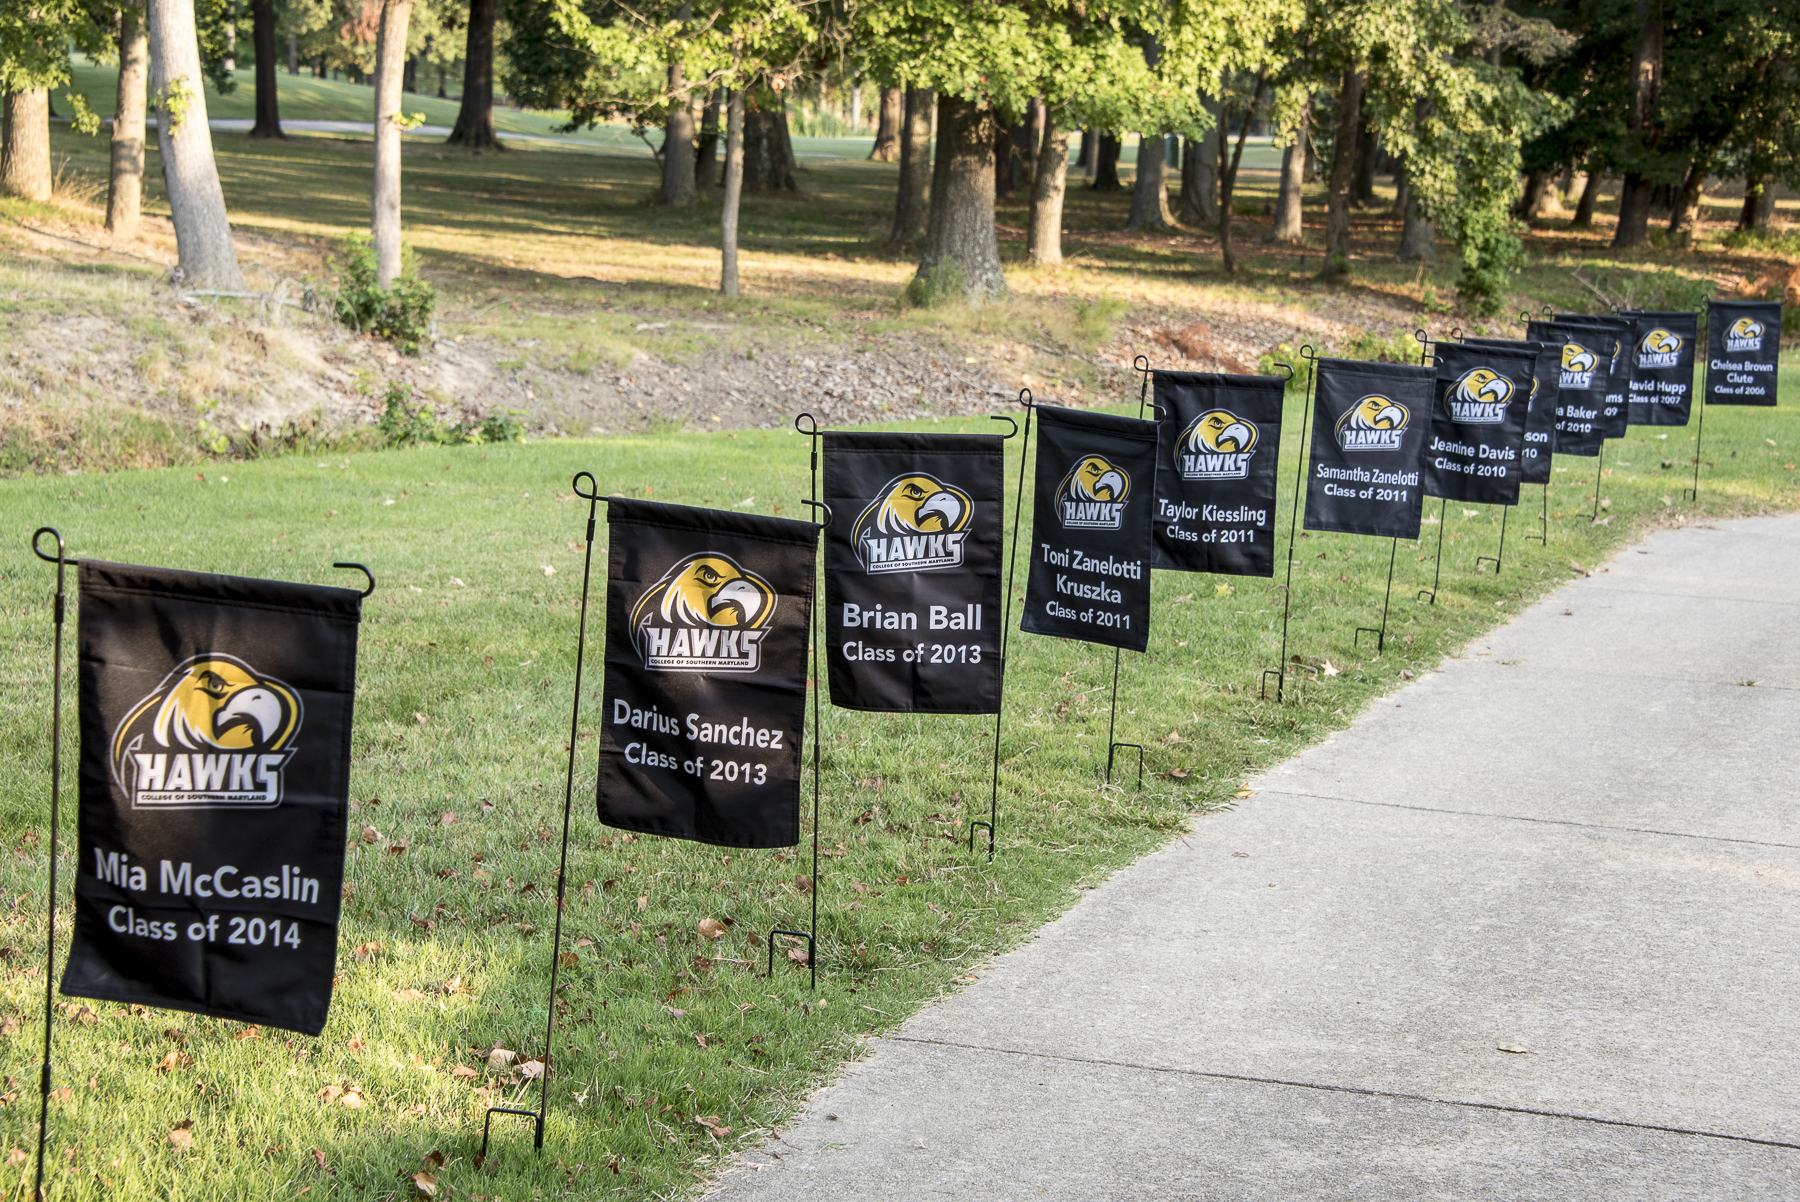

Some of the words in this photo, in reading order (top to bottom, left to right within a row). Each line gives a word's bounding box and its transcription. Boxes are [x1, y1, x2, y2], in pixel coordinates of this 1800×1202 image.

[1727, 337, 1762, 349] HAWKS
[1639, 352, 1679, 366] HAWKS
[1711, 359, 1743, 371] Chelsea
[1744, 361, 1773, 372] Brown
[1656, 380, 1687, 395] Hupp
[1726, 372, 1754, 384] Clute
[1650, 394, 1659, 403] of
[1660, 395, 1681, 404] 2007
[1714, 385, 1734, 394] Class
[1735, 385, 1744, 394] of
[1745, 386, 1766, 395] 2006
[1451, 402, 1507, 420] HAWKS
[1566, 405, 1598, 420] Baker
[1555, 420, 1566, 430] of
[1567, 422, 1592, 433] 2010
[1344, 430, 1403, 448] HAWKS
[1430, 436, 1475, 457] Jeanine
[1478, 444, 1516, 460] Davis
[1182, 453, 1251, 475] HAWKS
[1316, 463, 1371, 483] Samantha
[1372, 468, 1419, 486] Zanelotti
[1434, 457, 1461, 472] Class
[1463, 463, 1475, 475] of
[1477, 464, 1507, 478] 2010
[1324, 483, 1356, 498] Class
[1359, 487, 1374, 499] of
[1376, 488, 1408, 502] 2011
[1064, 501, 1124, 524] HAWKS
[1159, 498, 1199, 522] Taylor
[1202, 504, 1267, 526] Kiessling
[1166, 525, 1198, 541] Class
[1202, 529, 1217, 543] of
[1220, 529, 1255, 543] 2011
[866, 532, 965, 563] HAWKS
[1041, 543, 1070, 568] Toni
[1072, 549, 1142, 580] Zanelotti
[1056, 573, 1122, 604] Kruszka
[842, 602, 917, 630] Brian
[929, 603, 982, 631] Ball
[1045, 600, 1077, 620] Class
[1080, 608, 1094, 623] of
[1096, 610, 1131, 630] 2011
[646, 627, 764, 665] HAWKS
[842, 640, 896, 662] Class
[902, 643, 925, 663] of
[930, 643, 982, 664] 2013
[613, 698, 680, 736] Darius
[685, 712, 784, 750] Sanchez
[624, 742, 679, 771] Class
[683, 756, 704, 778] of
[710, 759, 768, 786] 2013
[133, 753, 286, 799] HAWKS
[141, 793, 173, 801] COLLEGE
[174, 793, 185, 801] OF
[186, 793, 226, 801] SOUTHERN
[94, 847, 148, 891] Mia
[160, 859, 321, 904] McCaslin
[108, 904, 178, 942] Class
[187, 914, 219, 943] of
[228, 916, 302, 949] 2014
